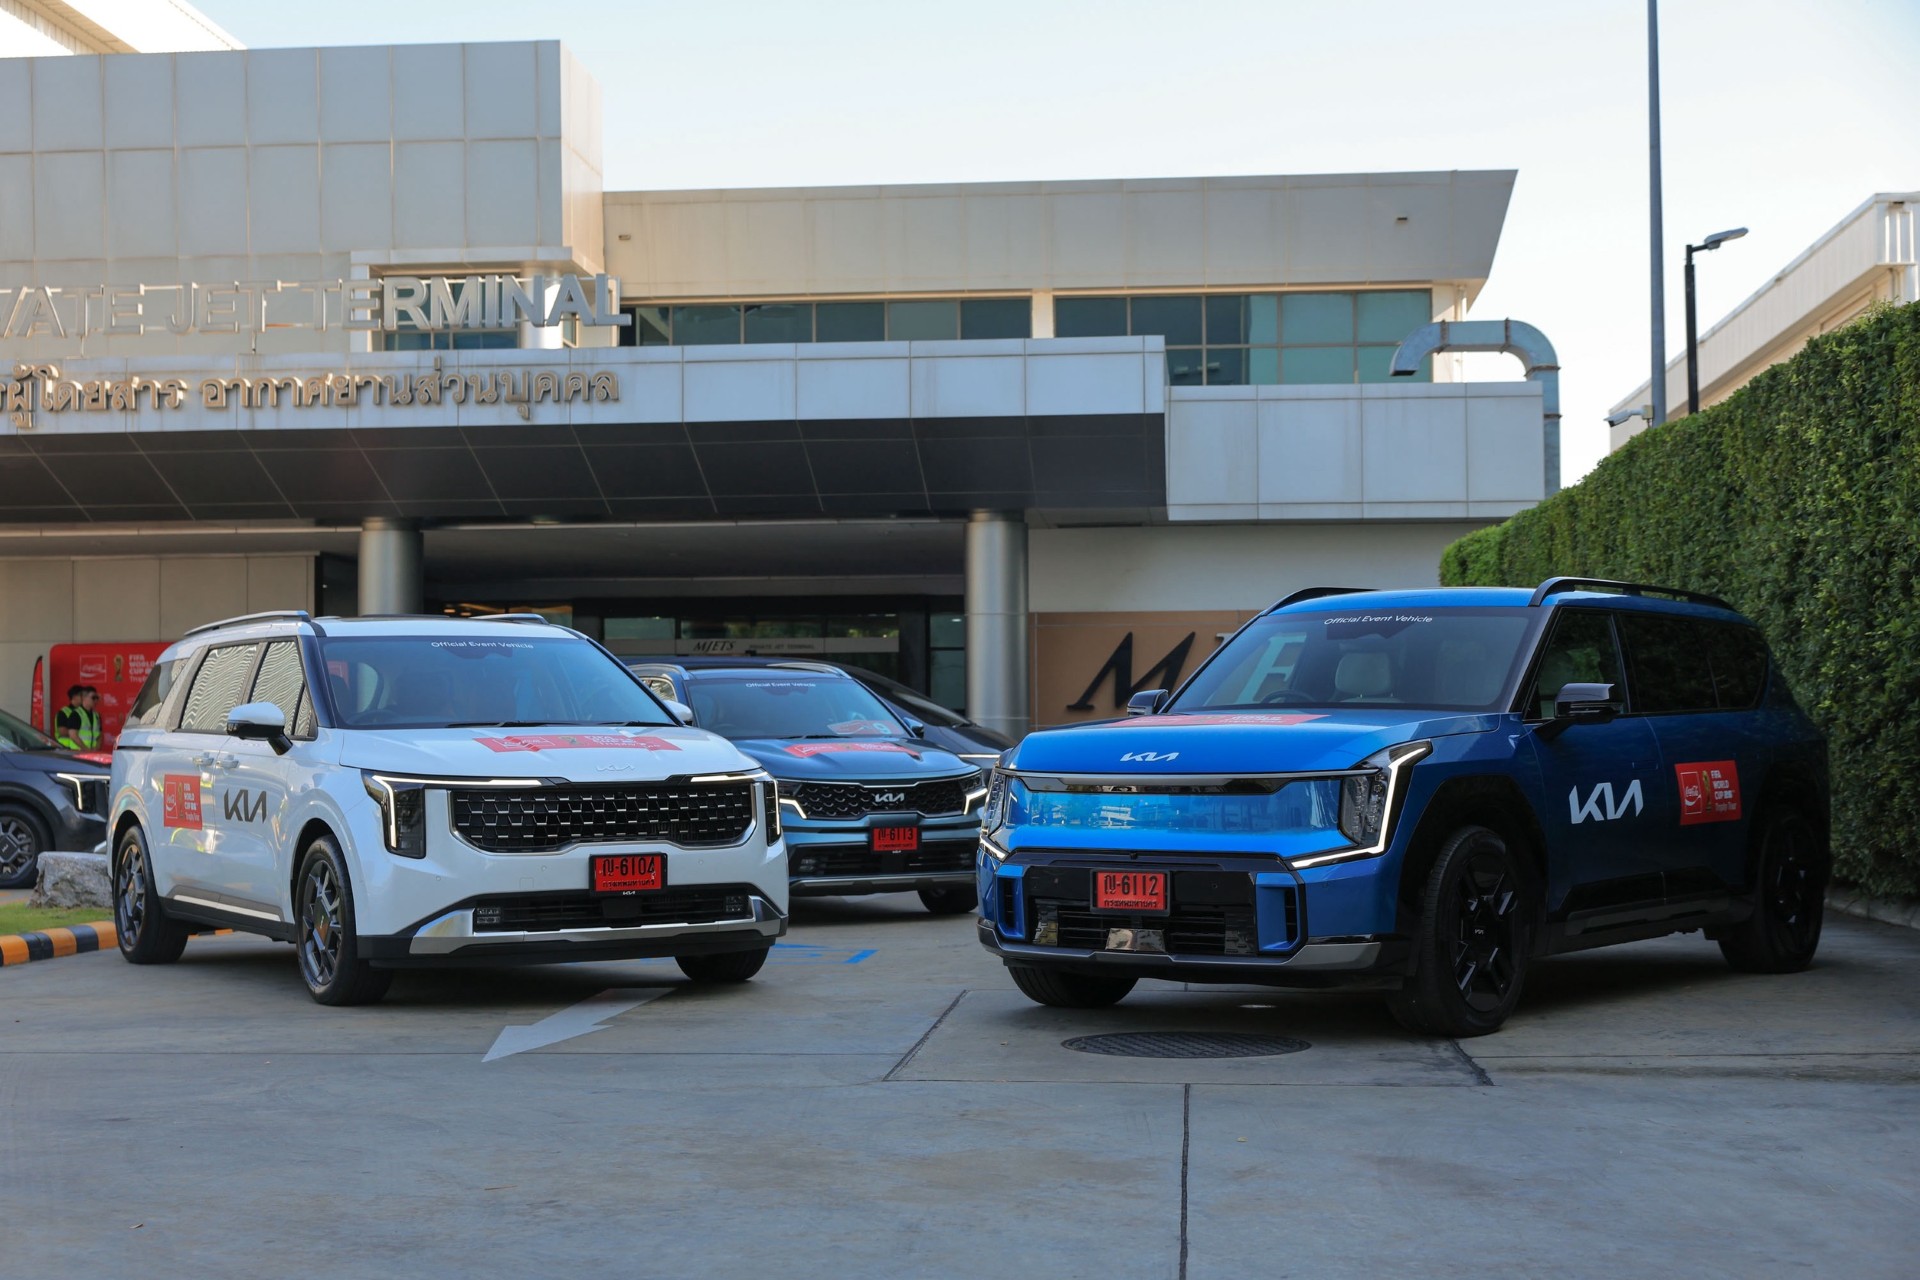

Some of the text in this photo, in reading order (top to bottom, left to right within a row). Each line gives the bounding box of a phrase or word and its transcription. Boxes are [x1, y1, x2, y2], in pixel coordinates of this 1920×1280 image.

[165, 280, 283, 336] JET
[299, 273, 632, 331] TERMINAL
[200, 354, 620, 421] อากาศยานส่วนบุคคล
[1324, 615, 1433, 625] Official Event Vehicle
[1120, 752, 1180, 762] KIA
[224, 788, 267, 824] KIA
[875, 793, 905, 802] KIA
[1569, 779, 1644, 824] KIA
